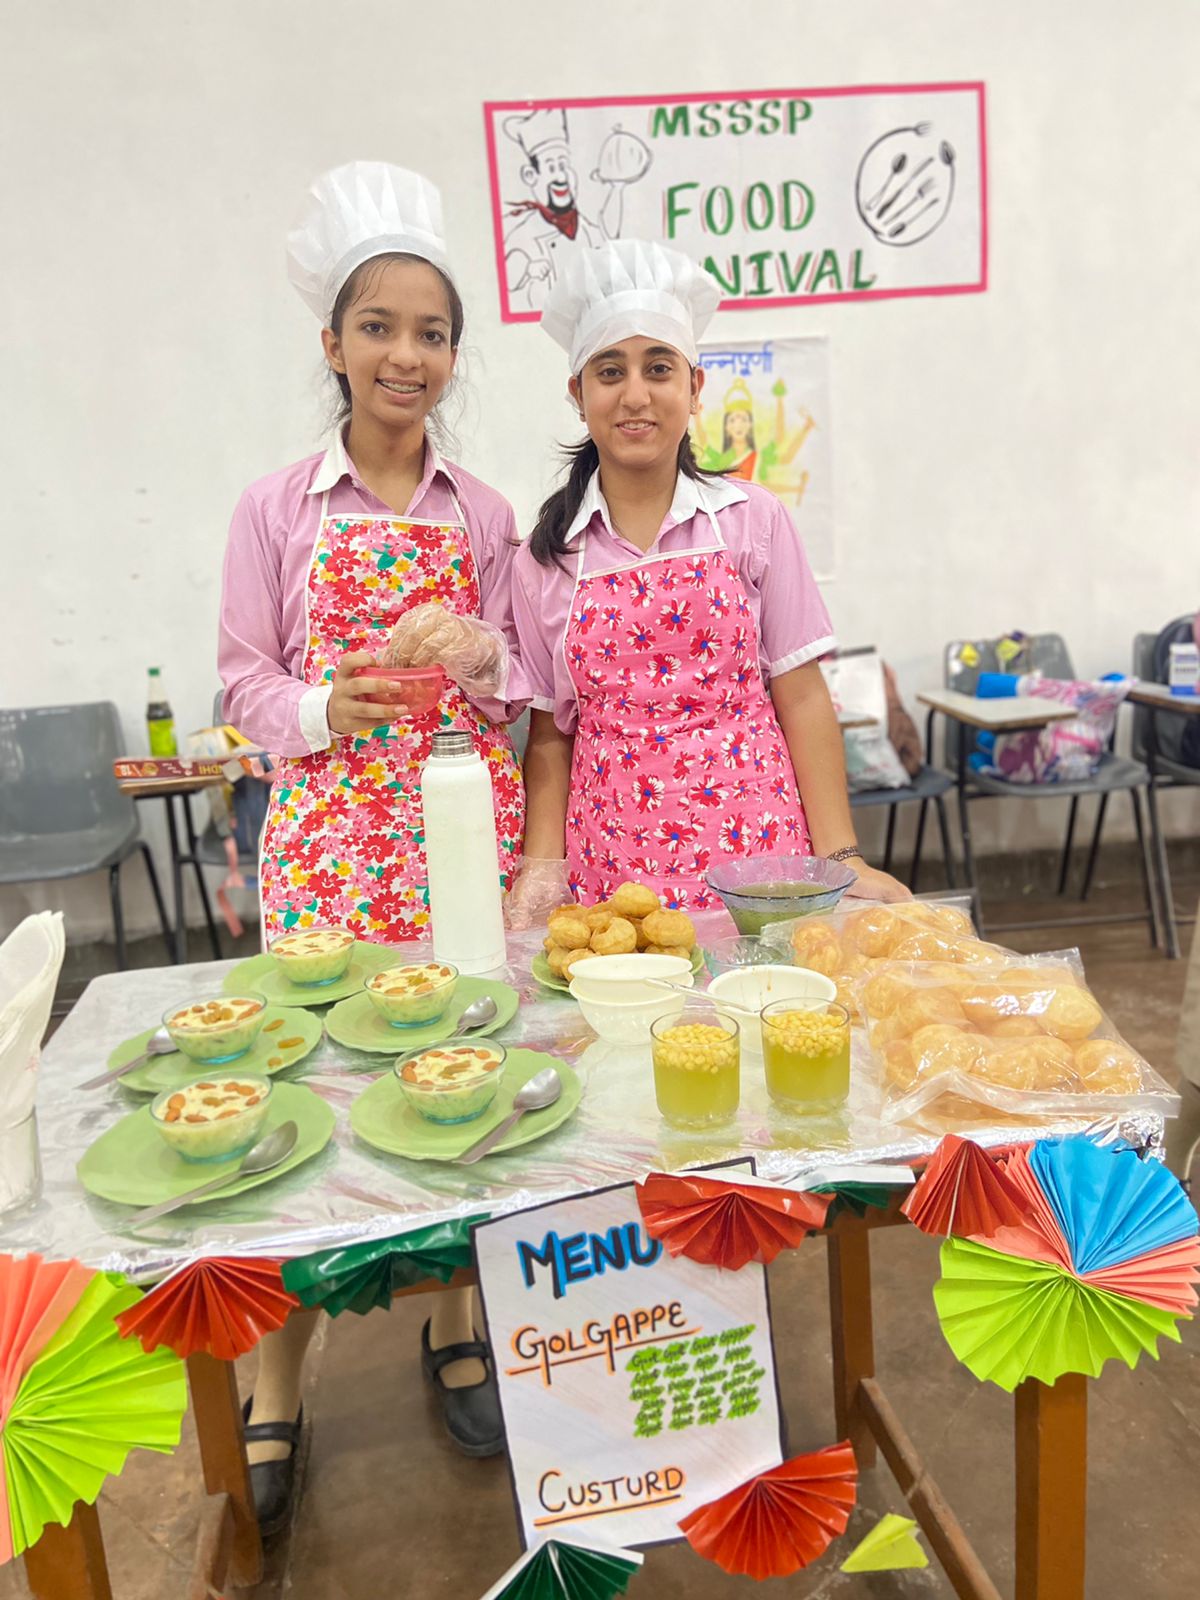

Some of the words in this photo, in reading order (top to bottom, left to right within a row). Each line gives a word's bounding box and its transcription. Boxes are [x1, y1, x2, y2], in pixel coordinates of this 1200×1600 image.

[650, 99, 814, 138] MSSSP
[662, 180, 816, 239] FOOD
[703, 249, 878, 297] NIVAL
[697, 340, 773, 376] न्नपूर्णा
[516, 1222, 664, 1299] MENU
[511, 1302, 687, 1385] GOLGAPPE
[537, 1467, 687, 1513] CUSTURD
